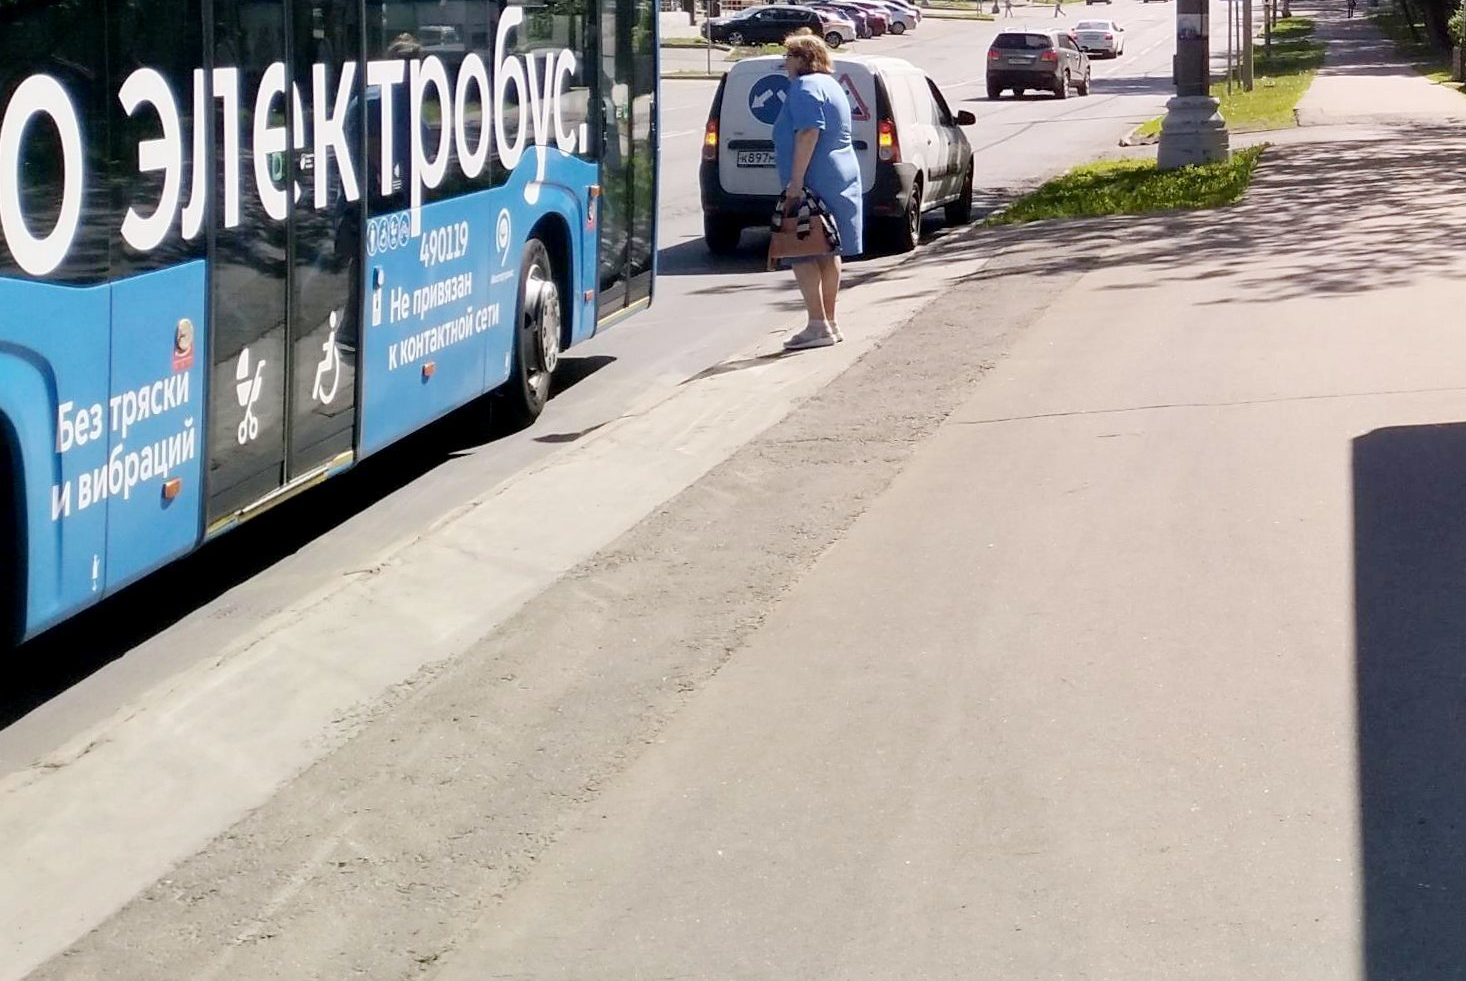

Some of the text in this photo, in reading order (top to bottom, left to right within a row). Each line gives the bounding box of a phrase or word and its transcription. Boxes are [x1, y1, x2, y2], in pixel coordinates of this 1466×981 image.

[118, 6, 589, 251] электробус.
[419, 221, 469, 267] 490119
[390, 272, 472, 324] Не привязан
[389, 302, 500, 371] к контактной сети
[56, 371, 190, 453] Без тряски
[51, 416, 195, 521] и вибраций
